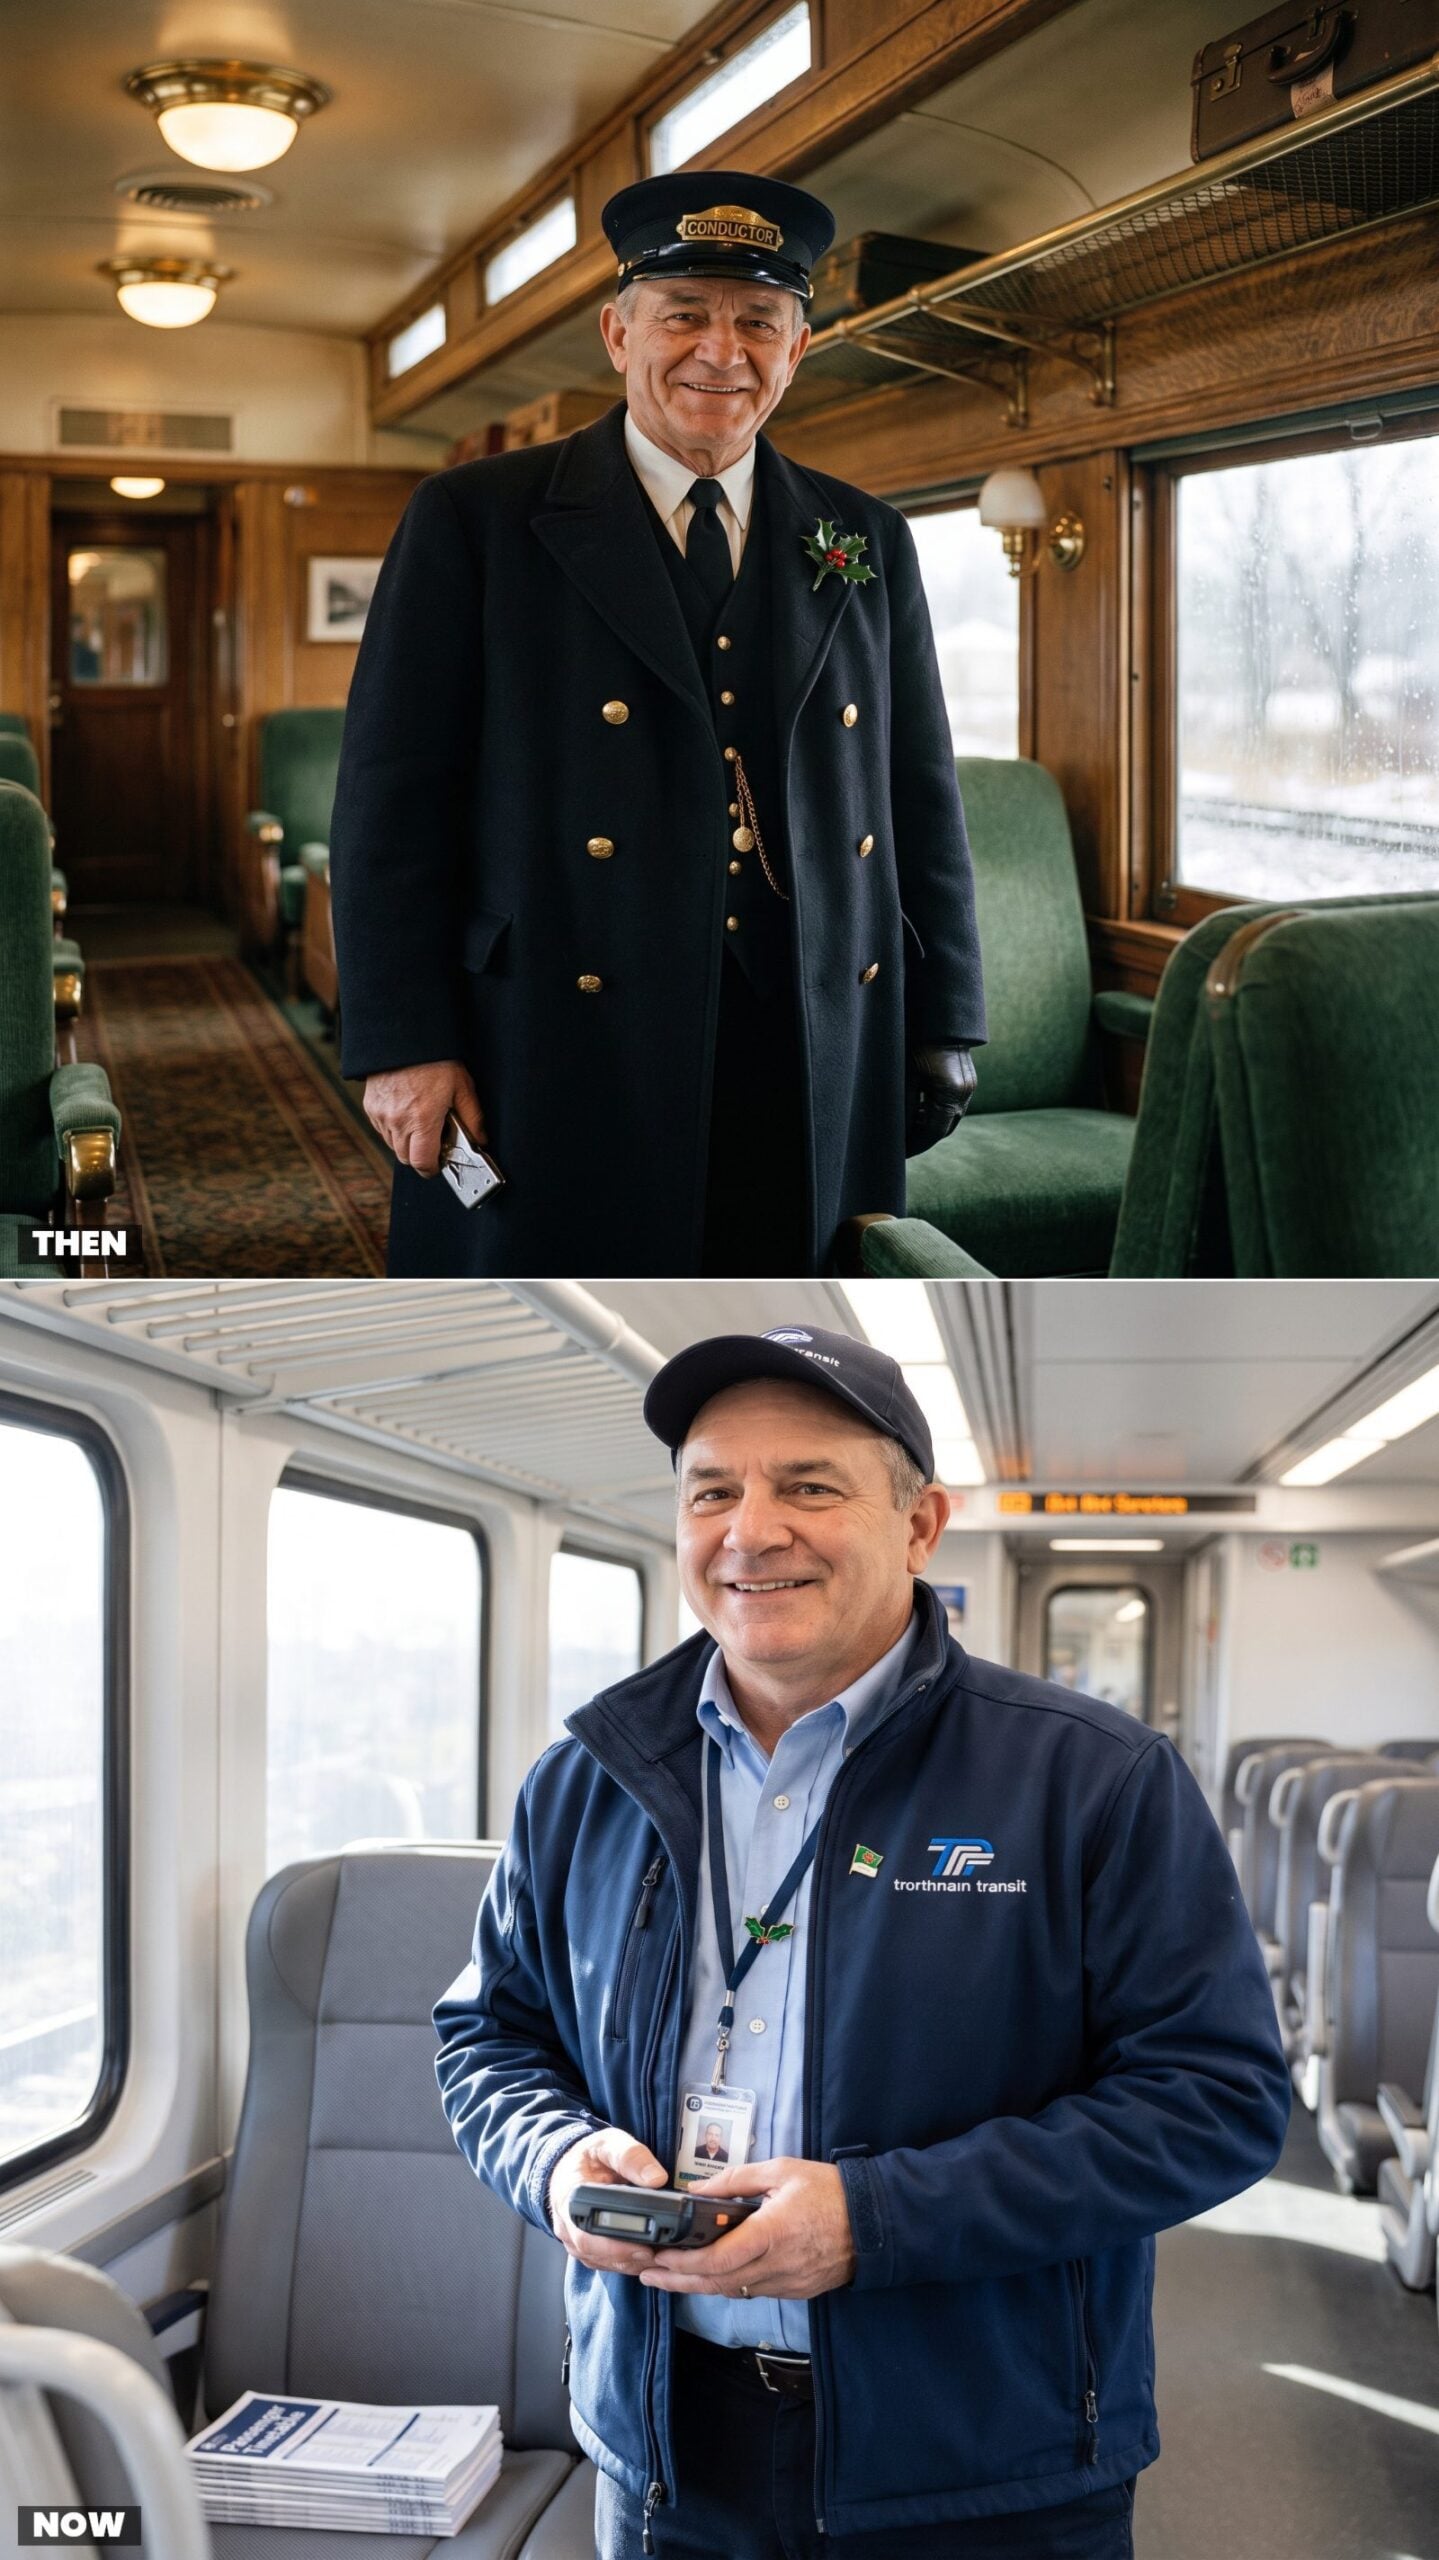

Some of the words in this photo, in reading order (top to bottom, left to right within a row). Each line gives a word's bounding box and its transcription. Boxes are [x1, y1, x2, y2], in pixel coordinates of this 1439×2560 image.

[687, 221, 774, 244] CONDUCTOR
[794, 1347, 840, 1367] ransit
[976, 1878, 1027, 1893] transit
